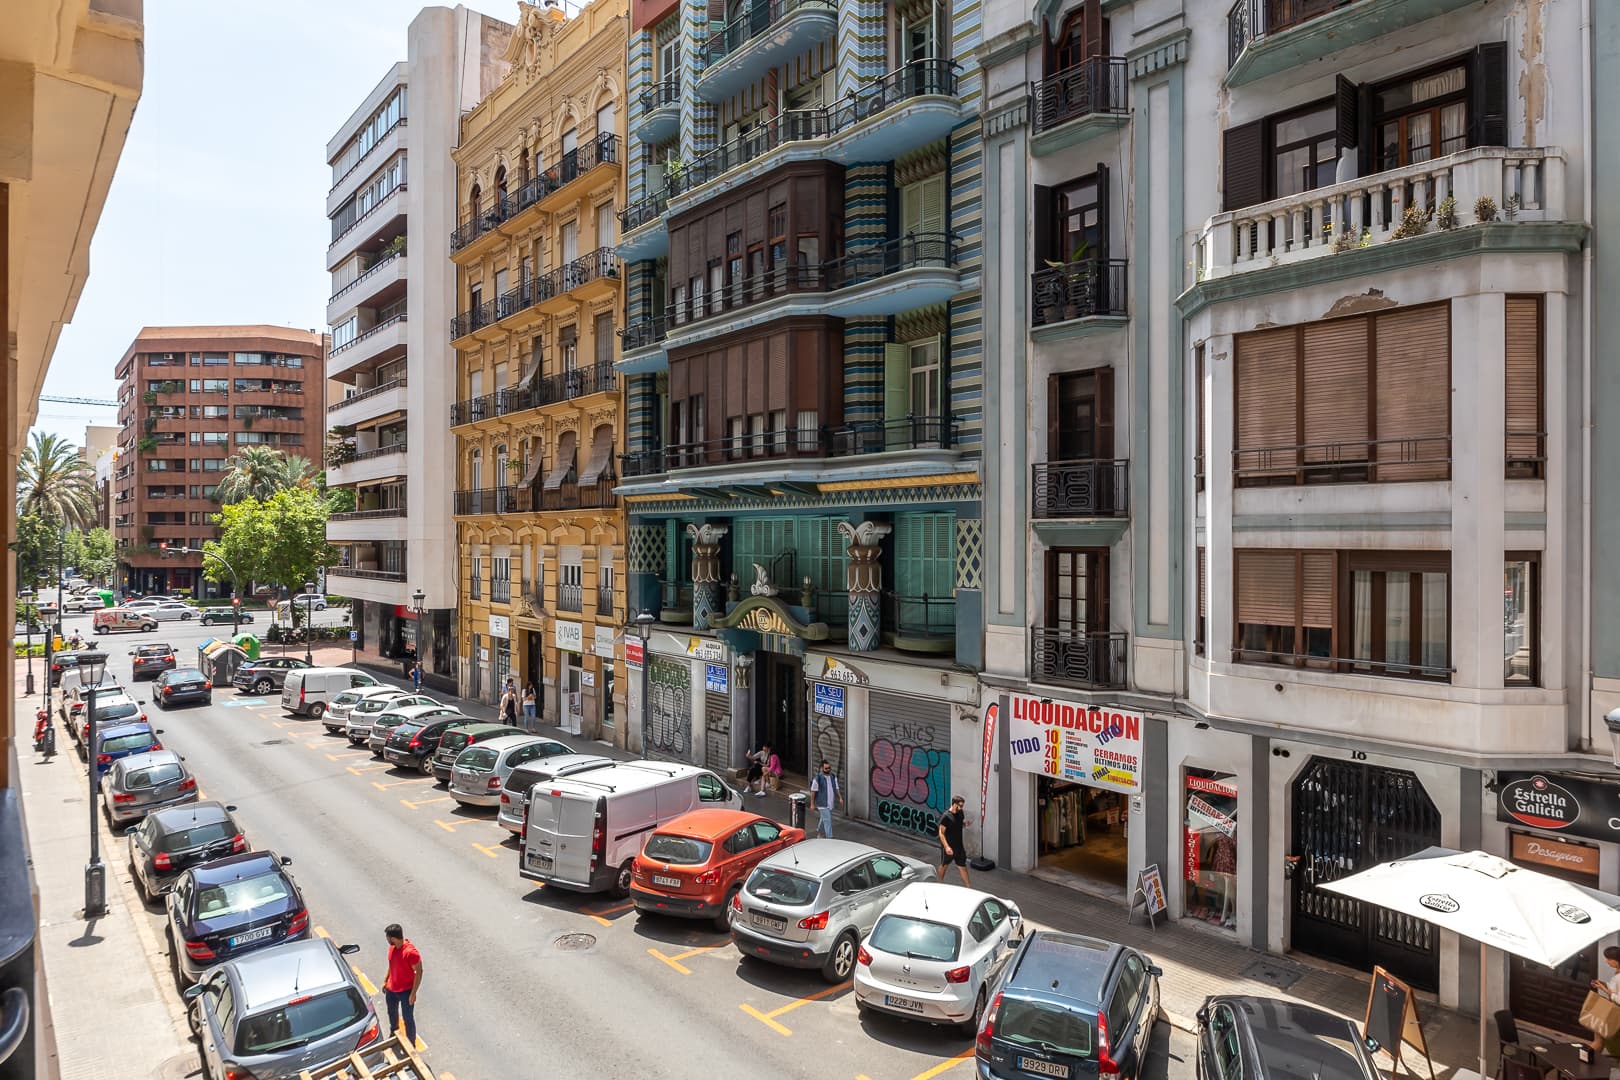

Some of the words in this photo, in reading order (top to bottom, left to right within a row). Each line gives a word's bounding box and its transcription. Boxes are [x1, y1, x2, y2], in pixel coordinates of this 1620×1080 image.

[817, 686, 826, 695] LA
[828, 687, 842, 698] SEU
[1013, 697, 1140, 741] LIQUIDACION
[1045, 729, 1059, 745] 10
[1011, 736, 1041, 756] TODO
[1045, 744, 1058, 760] 20
[1094, 748, 1138, 766] CERRAMOS
[1044, 759, 1057, 775] 30
[1092, 766, 1110, 781] FINAL
[1122, 762, 1138, 773] DIAS
[1514, 787, 1567, 807] Estrella
[1516, 799, 1564, 819] Galicia
[1023, 1058, 1046, 1072] 9929
[1048, 1063, 1067, 1077] DRV
